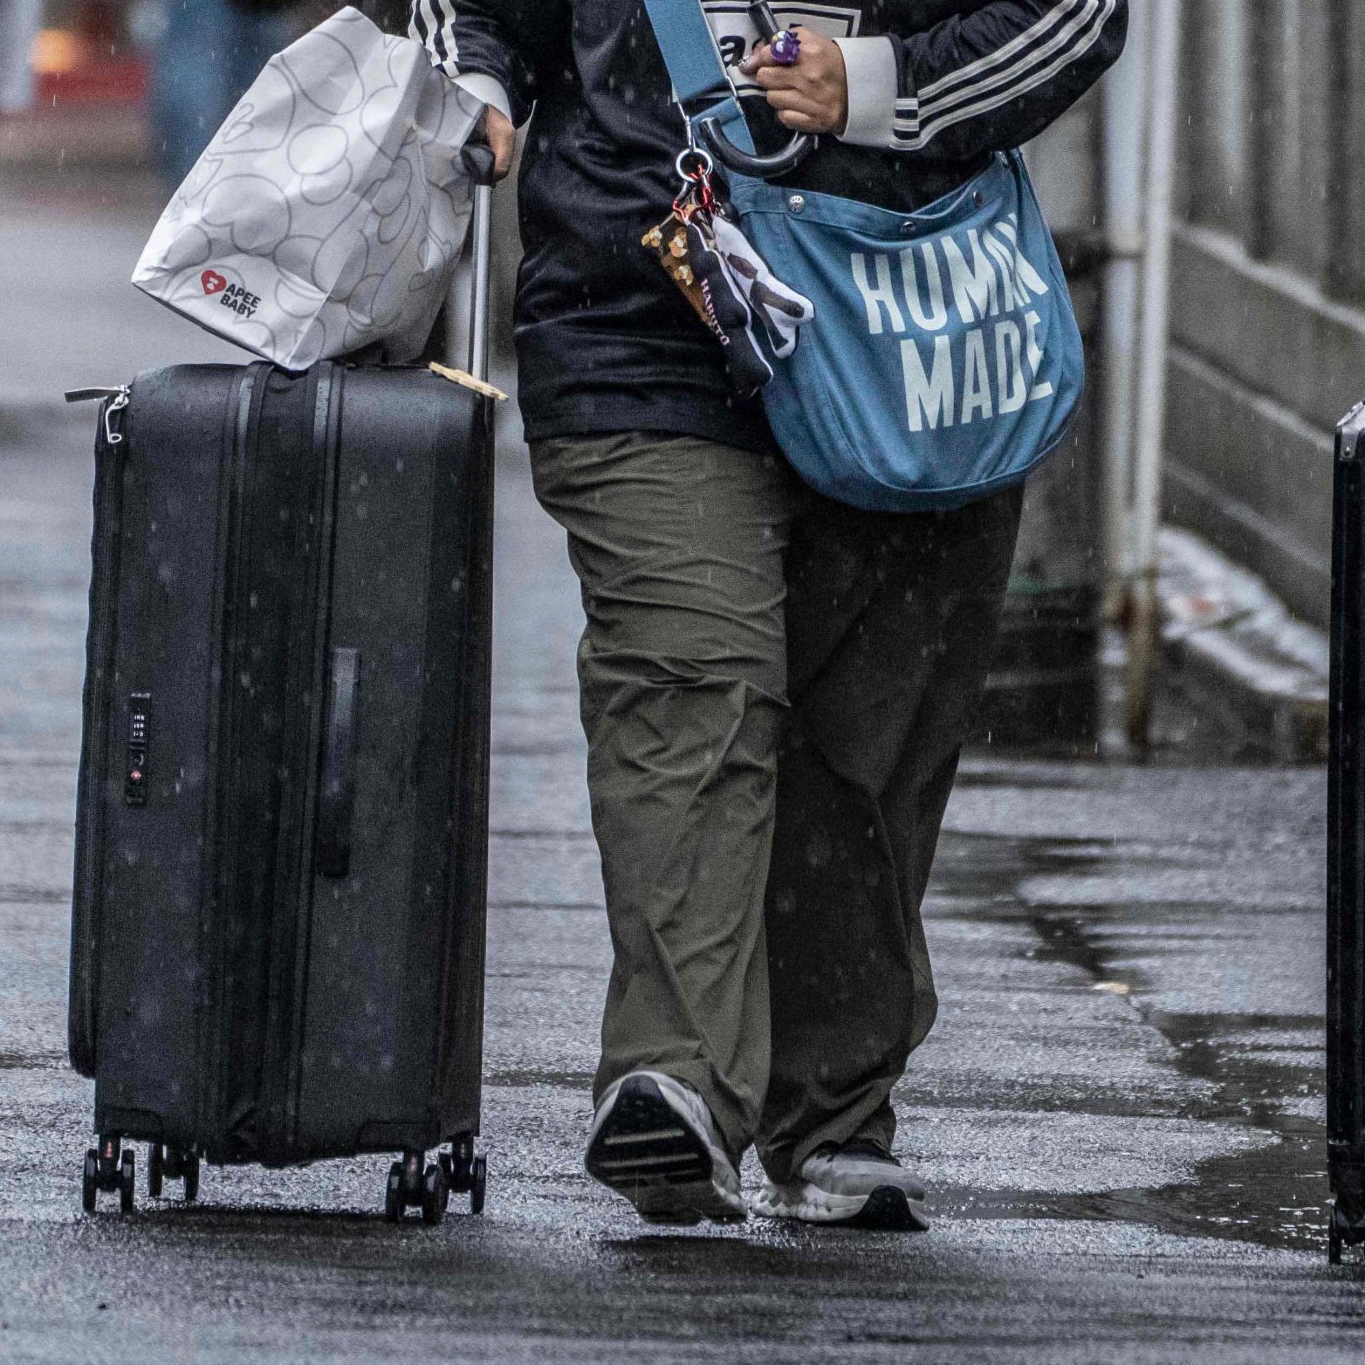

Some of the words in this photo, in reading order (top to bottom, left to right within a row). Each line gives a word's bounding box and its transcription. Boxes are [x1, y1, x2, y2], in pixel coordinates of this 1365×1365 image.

[220, 293, 256, 319] BABY
[225, 283, 262, 309] APEE
[700, 278, 730, 346] HARUTO
[900, 310, 1053, 432] MADE
